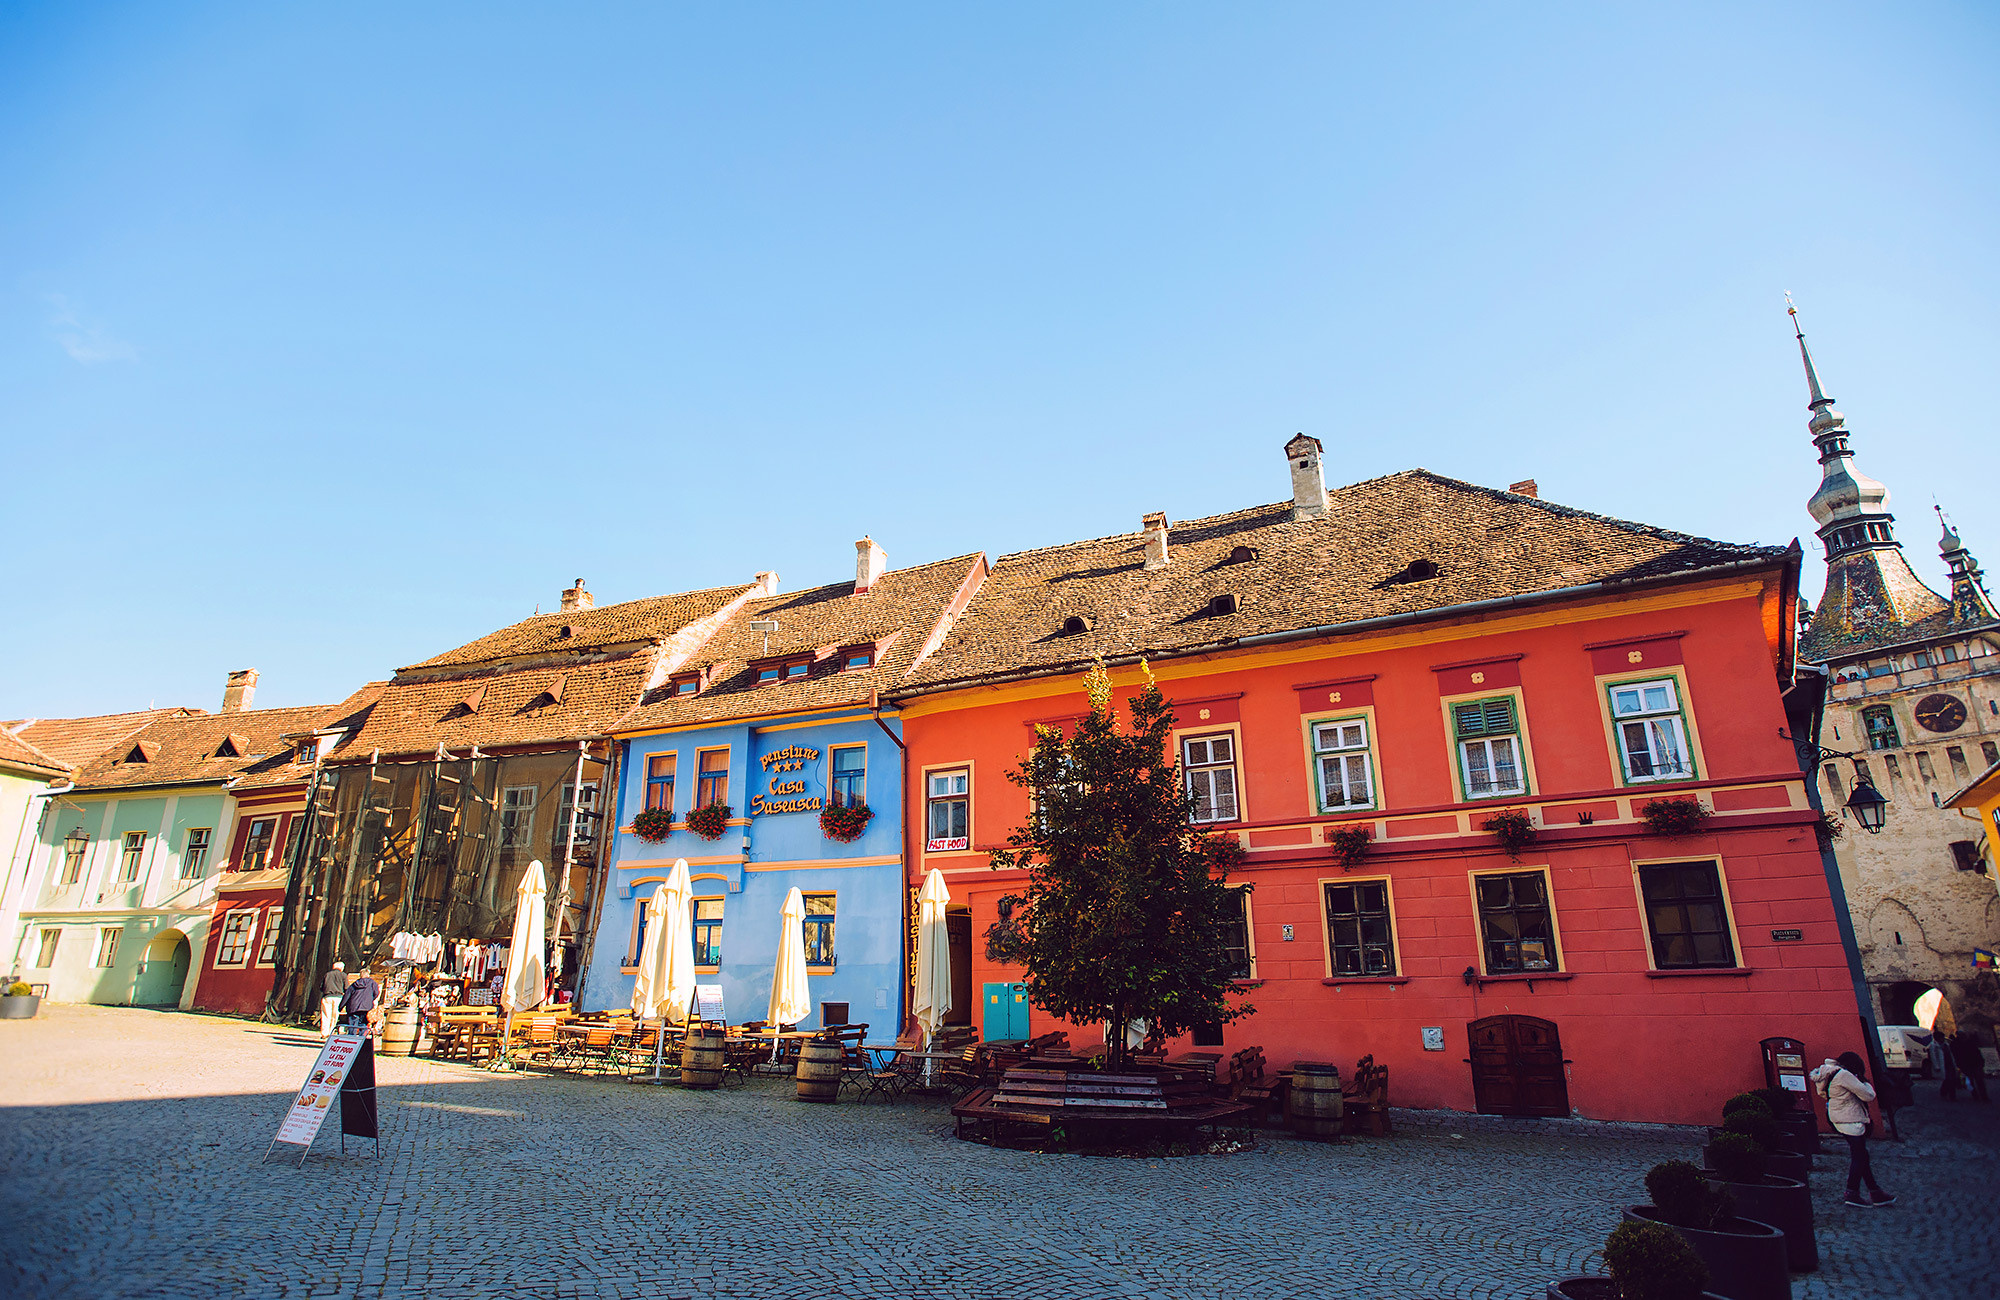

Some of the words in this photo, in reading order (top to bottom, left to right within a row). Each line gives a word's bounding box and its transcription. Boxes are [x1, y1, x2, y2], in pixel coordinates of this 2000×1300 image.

[759, 744, 820, 772] pensiune
[768, 776, 806, 796] Casa
[750, 794, 822, 816] Saseasca
[928, 839, 946, 850] FAST
[947, 837, 967, 849] FOOD
